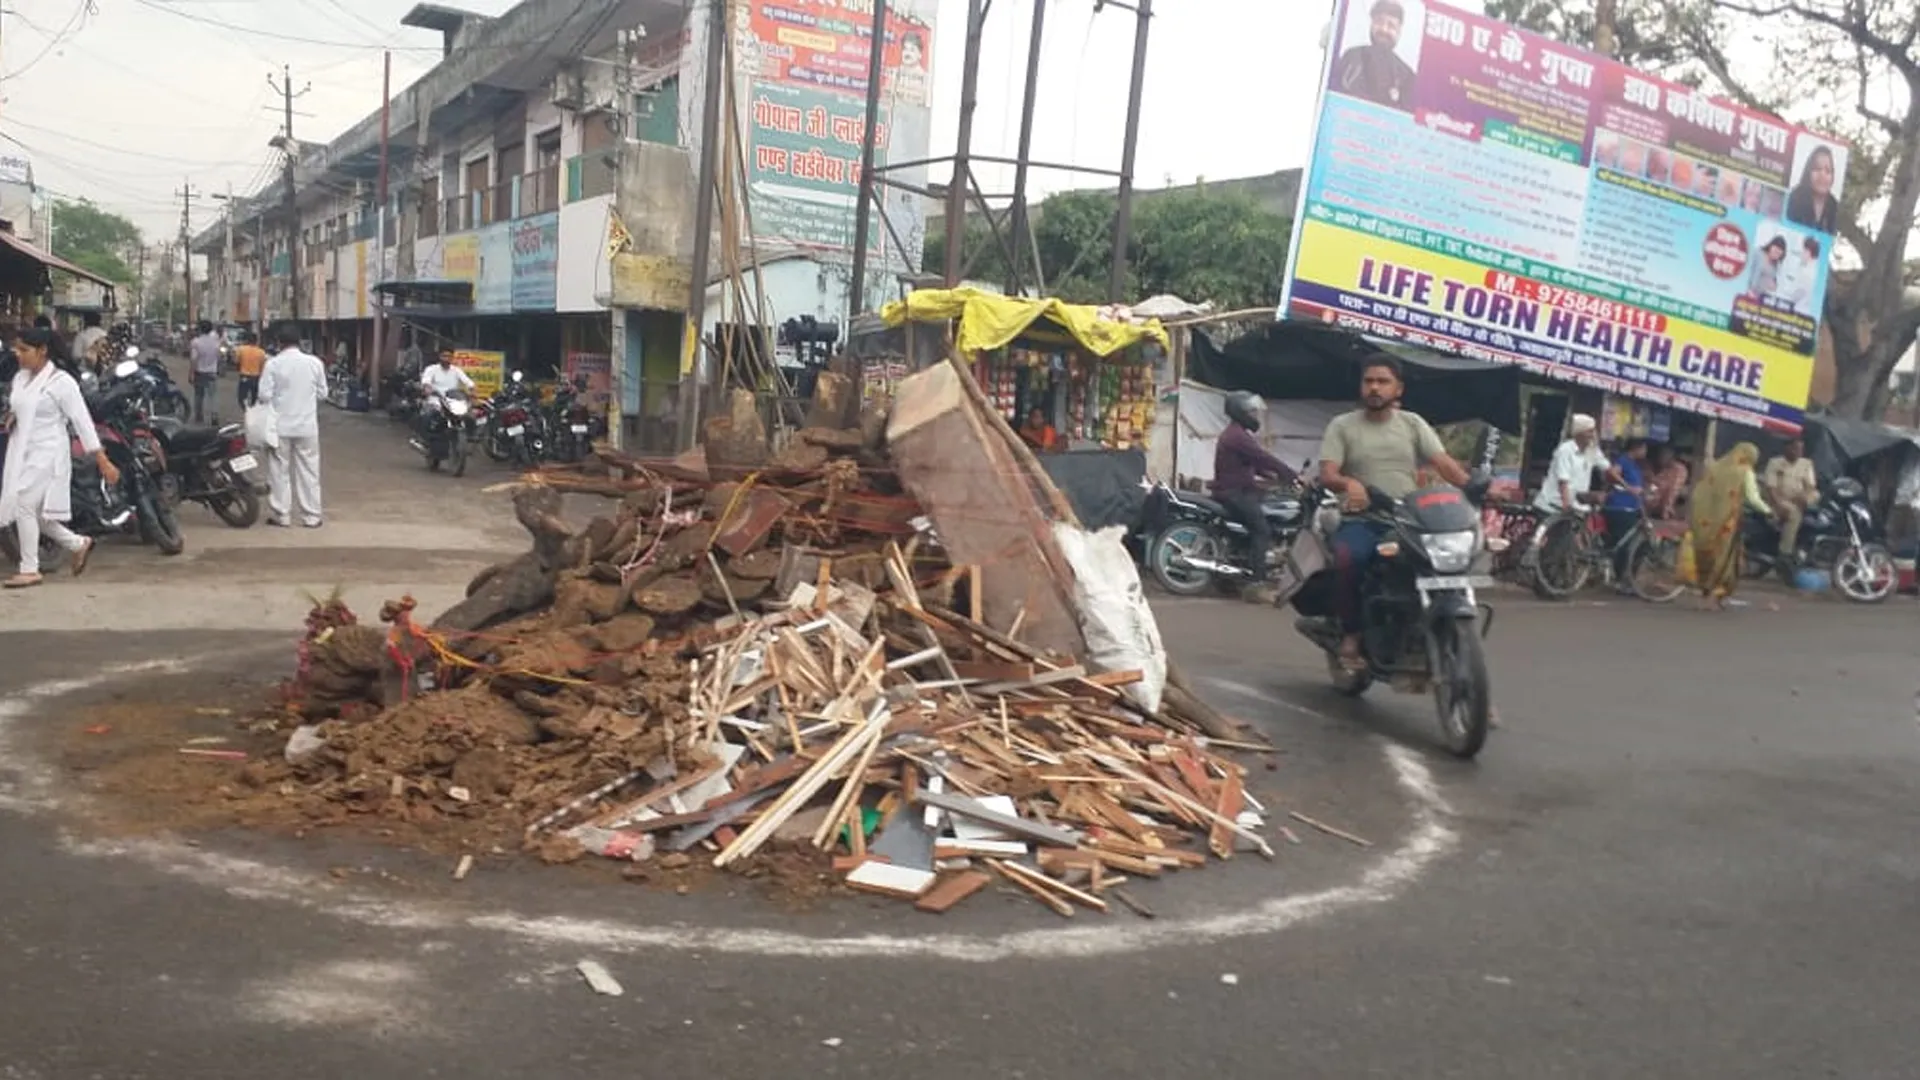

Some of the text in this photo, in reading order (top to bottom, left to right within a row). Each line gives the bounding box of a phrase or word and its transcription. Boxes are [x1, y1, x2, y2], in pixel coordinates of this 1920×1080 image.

[1541, 48, 1595, 89] गुप्ता
[753, 95, 802, 133] गोपाल
[806, 105, 827, 137] जी
[1738, 113, 1788, 153] गुप्ता
[756, 145, 788, 175] एण्ड
[1359, 258, 1433, 306] LIFE
[1444, 279, 1540, 333] TORN
[1547, 307, 1672, 366] HEALTH
[1679, 344, 1764, 391] CARE
[1538, 284, 1657, 329] 9758461111
